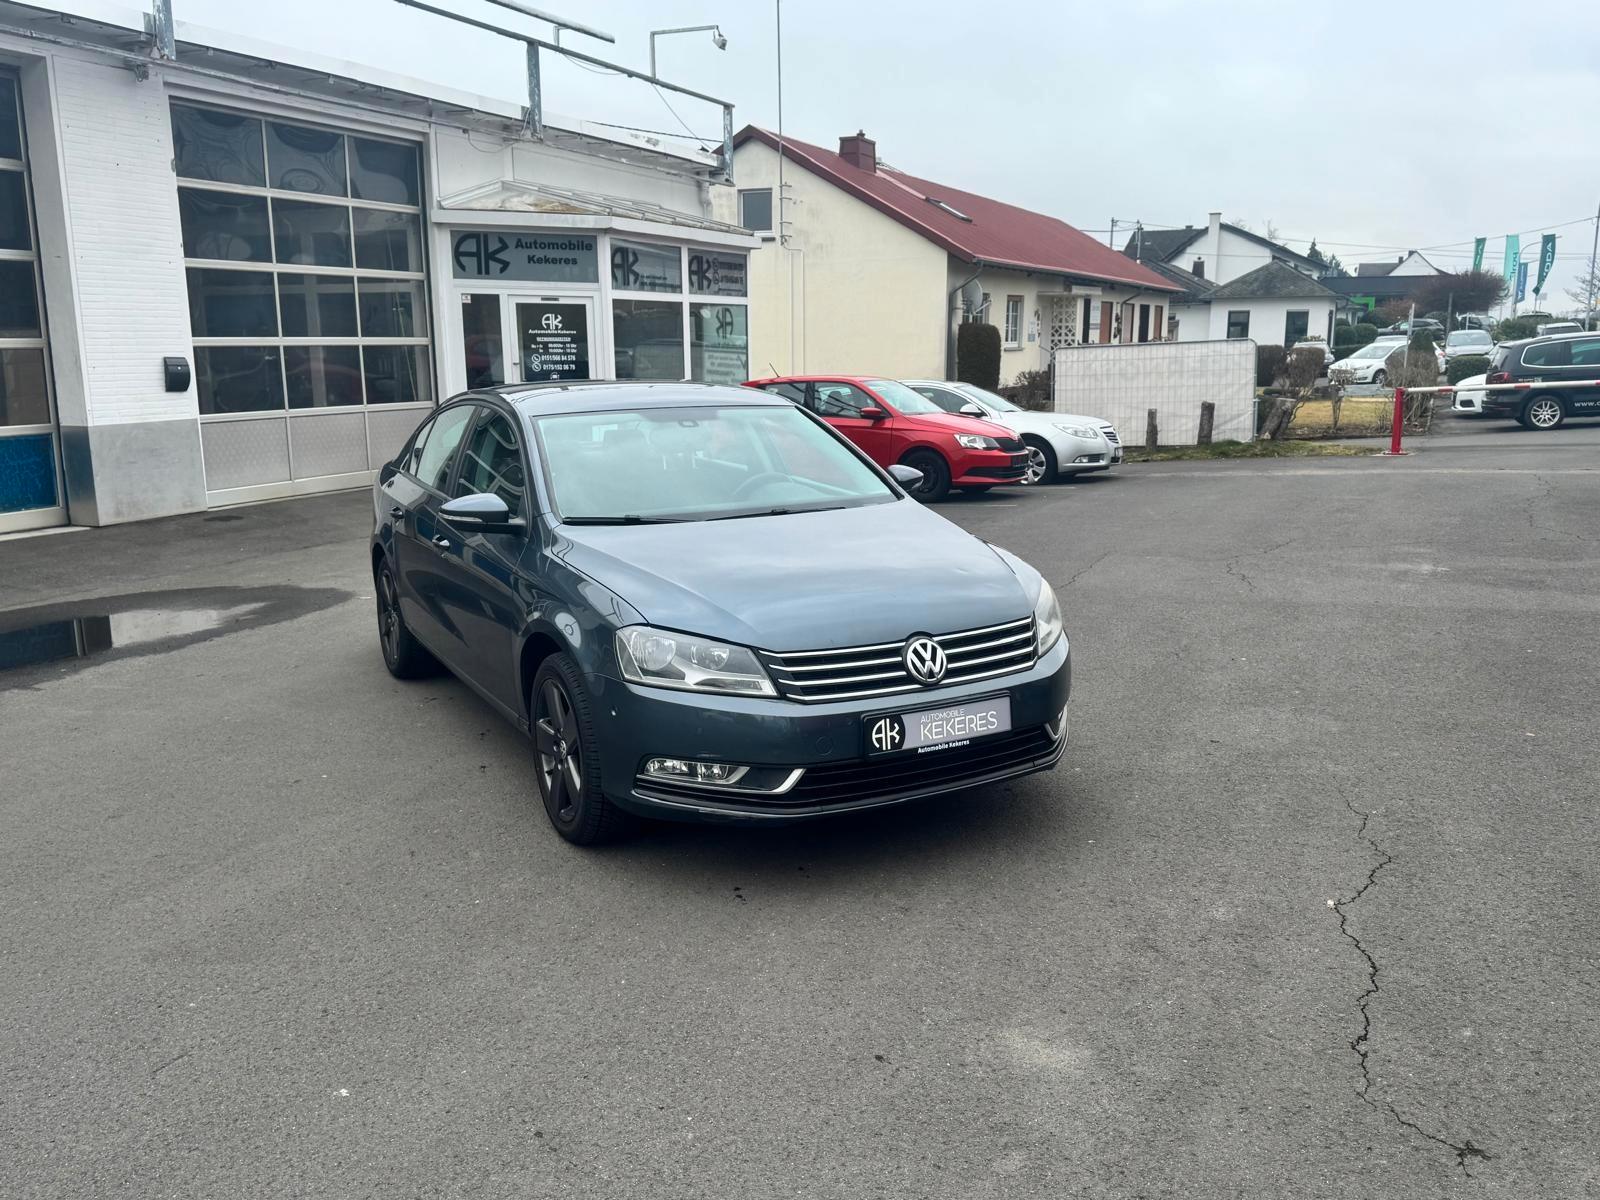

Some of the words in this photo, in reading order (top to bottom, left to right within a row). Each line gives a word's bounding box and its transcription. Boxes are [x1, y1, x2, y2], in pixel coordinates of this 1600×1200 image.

[514, 238, 593, 251] Automobile
[454, 233, 511, 275] AK
[527, 254, 578, 265] Kekeres
[920, 708, 965, 723] AUTOMOBILE
[920, 711, 998, 741] KEKERES
[872, 718, 900, 751] AK
[917, 743, 948, 754] Automobile
[949, 739, 970, 748] Kekeres
